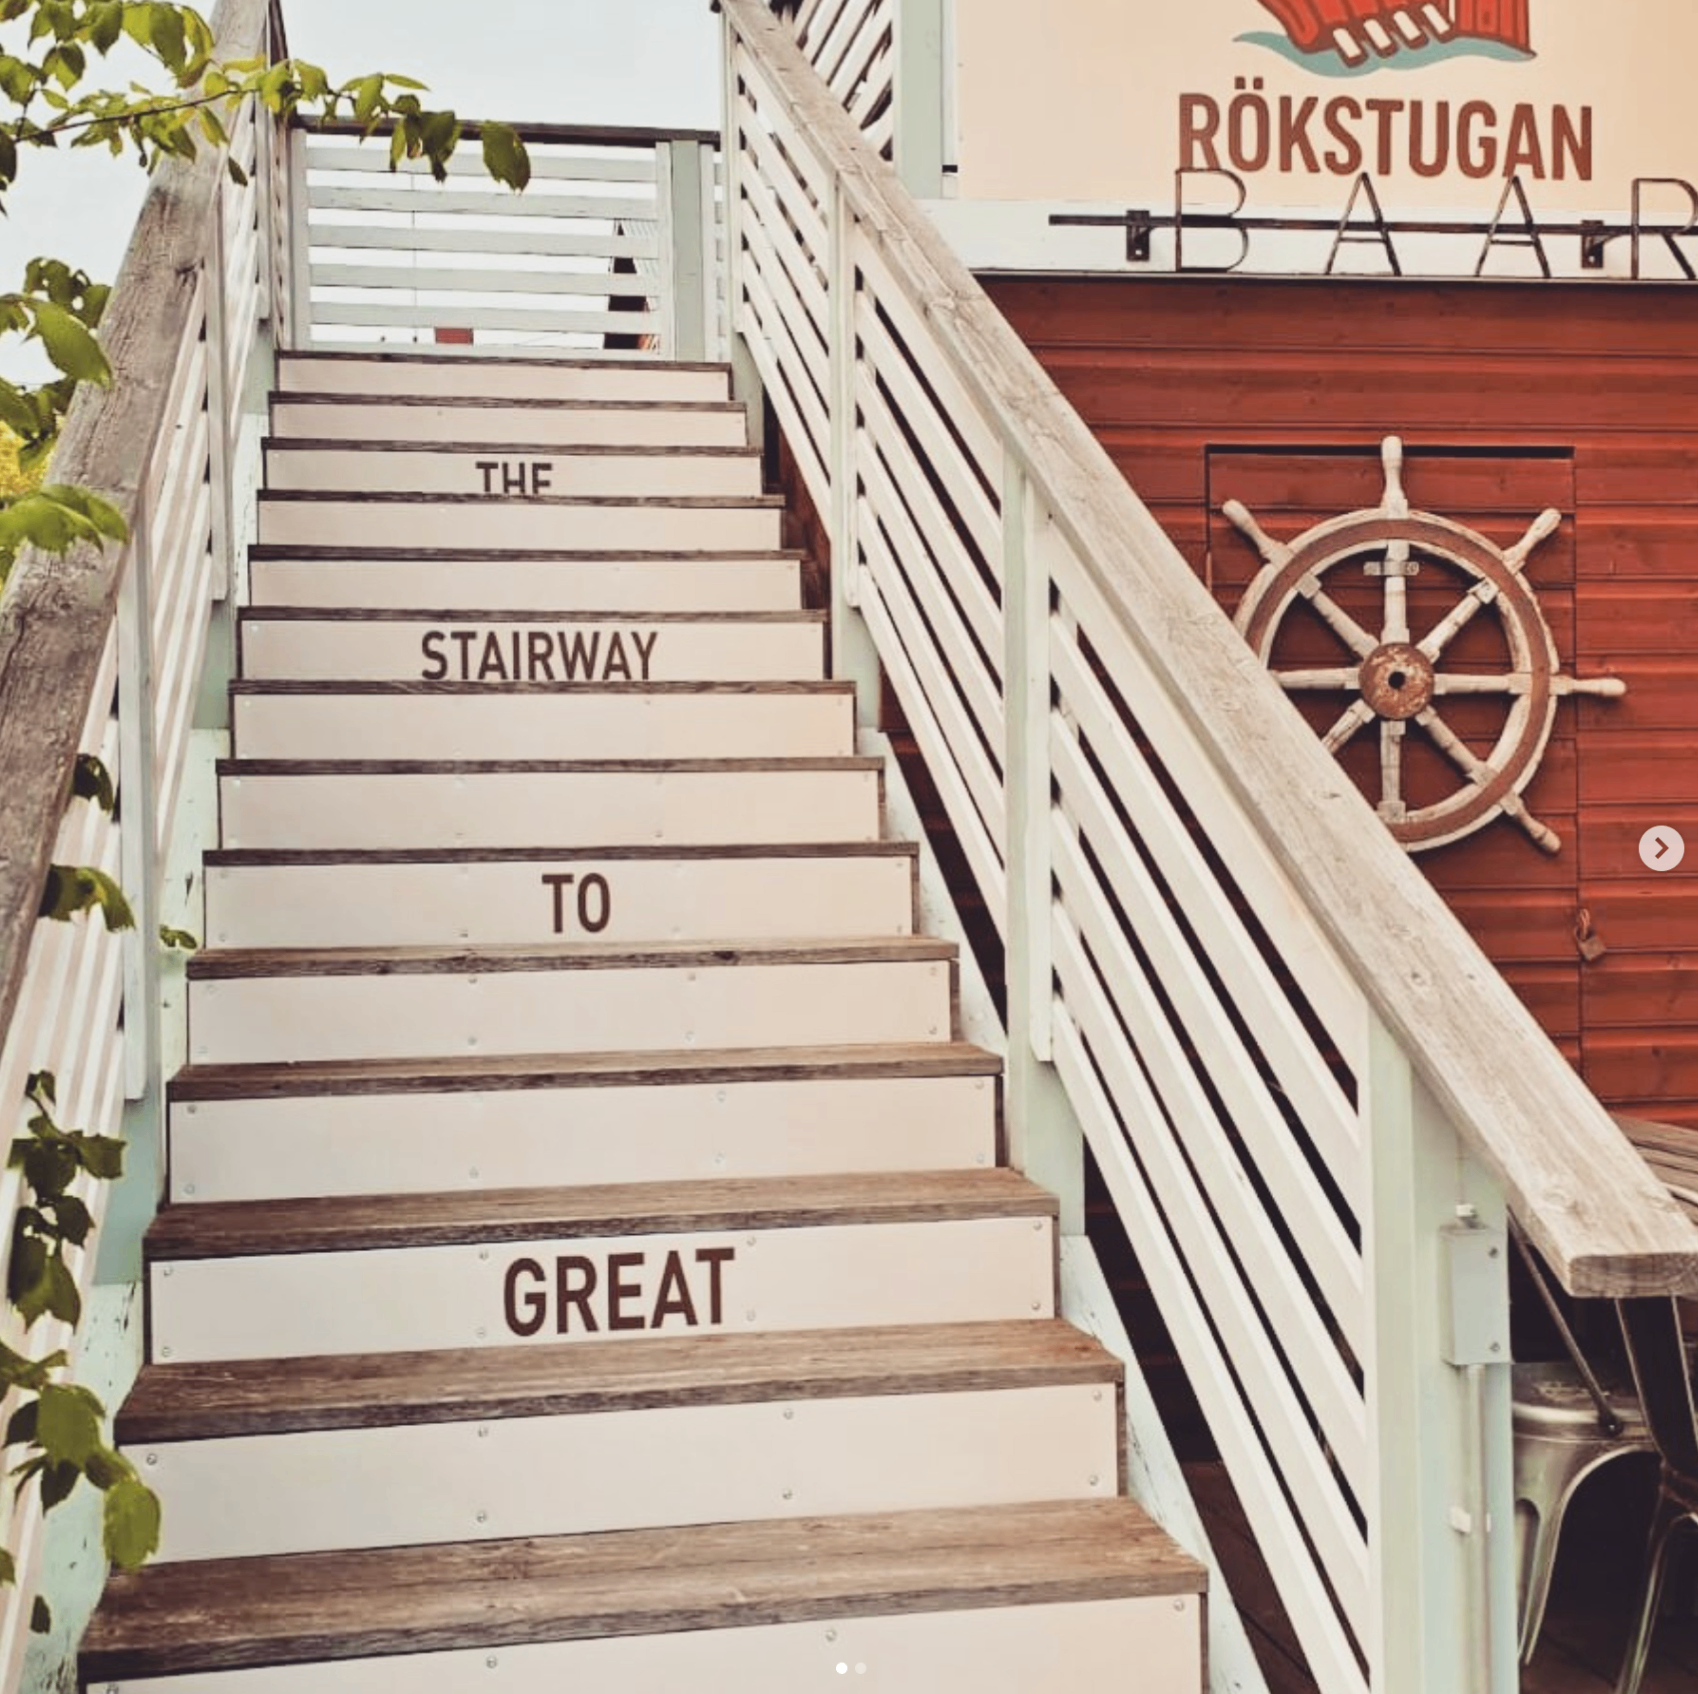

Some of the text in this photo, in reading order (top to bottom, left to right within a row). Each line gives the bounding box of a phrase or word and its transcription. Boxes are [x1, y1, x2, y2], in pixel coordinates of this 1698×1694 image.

[1178, 76, 1593, 181] RÖKSTUGAN
[475, 461, 553, 495] THE
[420, 630, 658, 681] STAIRWAY
[541, 872, 611, 934] TO
[503, 1247, 736, 1337] GREAT
